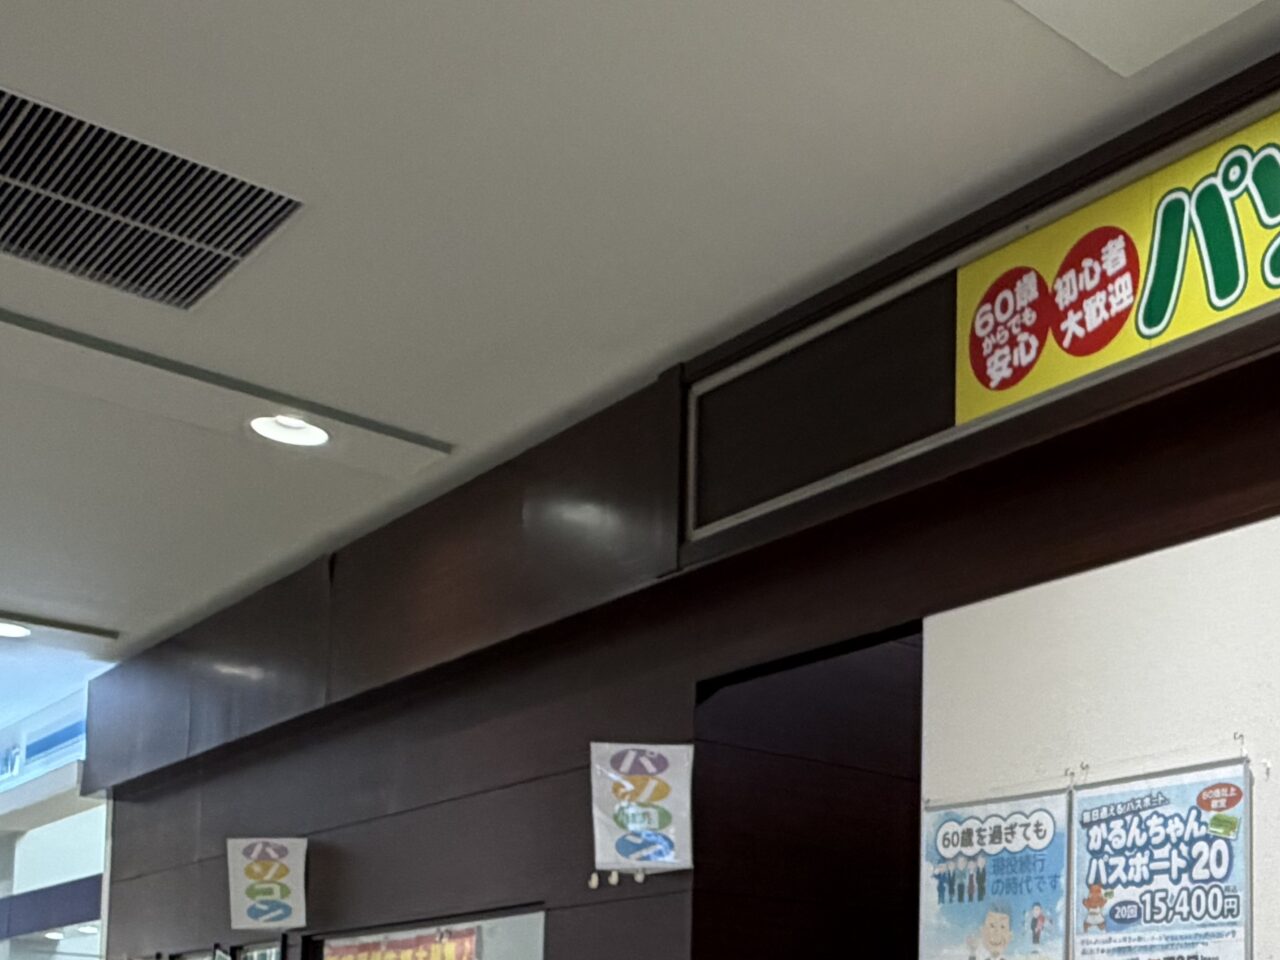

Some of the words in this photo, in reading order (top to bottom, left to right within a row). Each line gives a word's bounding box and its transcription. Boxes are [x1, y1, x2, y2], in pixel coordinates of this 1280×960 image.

[1054, 234, 1128, 311] 初心者
[974, 270, 1040, 338] 60歳
[1059, 271, 1135, 349] 大歓迎
[981, 306, 1038, 357] からでも
[985, 331, 1040, 389] 安心
[941, 819, 1047, 849] 60歳を過ぎても
[1088, 808, 1207, 850] かるんちゃん
[1114, 904, 1138, 919] 20回
[1141, 885, 1240, 923] 15,400円
